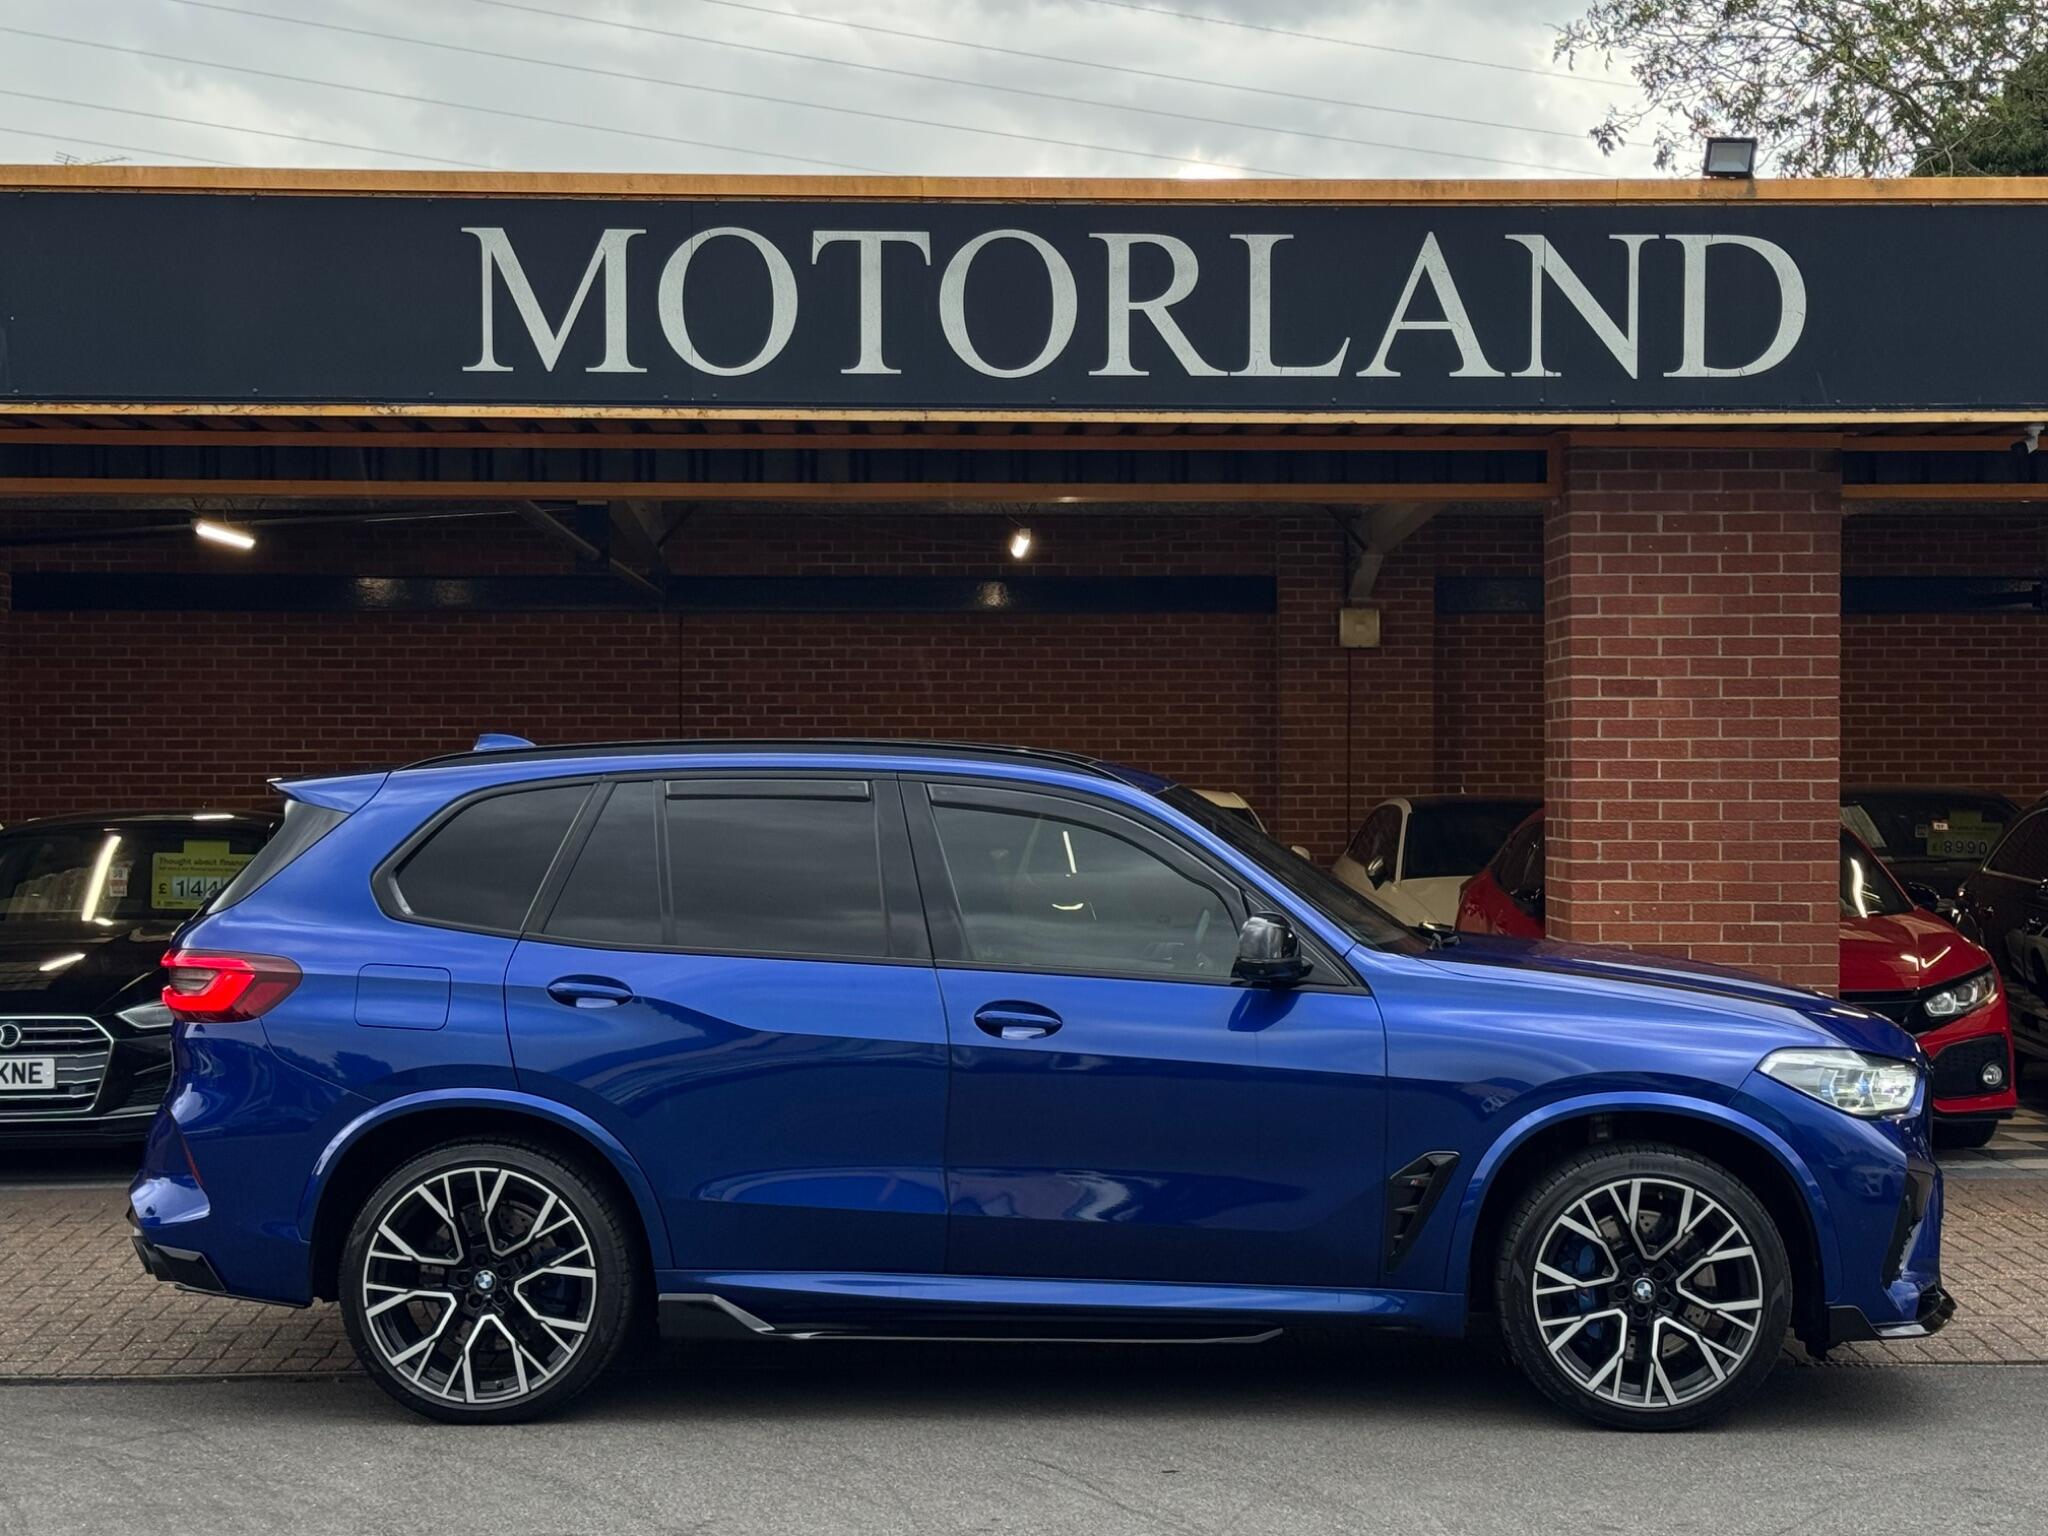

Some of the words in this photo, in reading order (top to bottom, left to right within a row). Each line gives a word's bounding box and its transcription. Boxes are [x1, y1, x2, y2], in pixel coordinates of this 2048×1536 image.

[461, 227, 1807, 380] MOTORLAND
[1944, 840, 1987, 854] 8990
[160, 857, 192, 866] Thought
[194, 857, 217, 866] about
[158, 882, 168, 895] £
